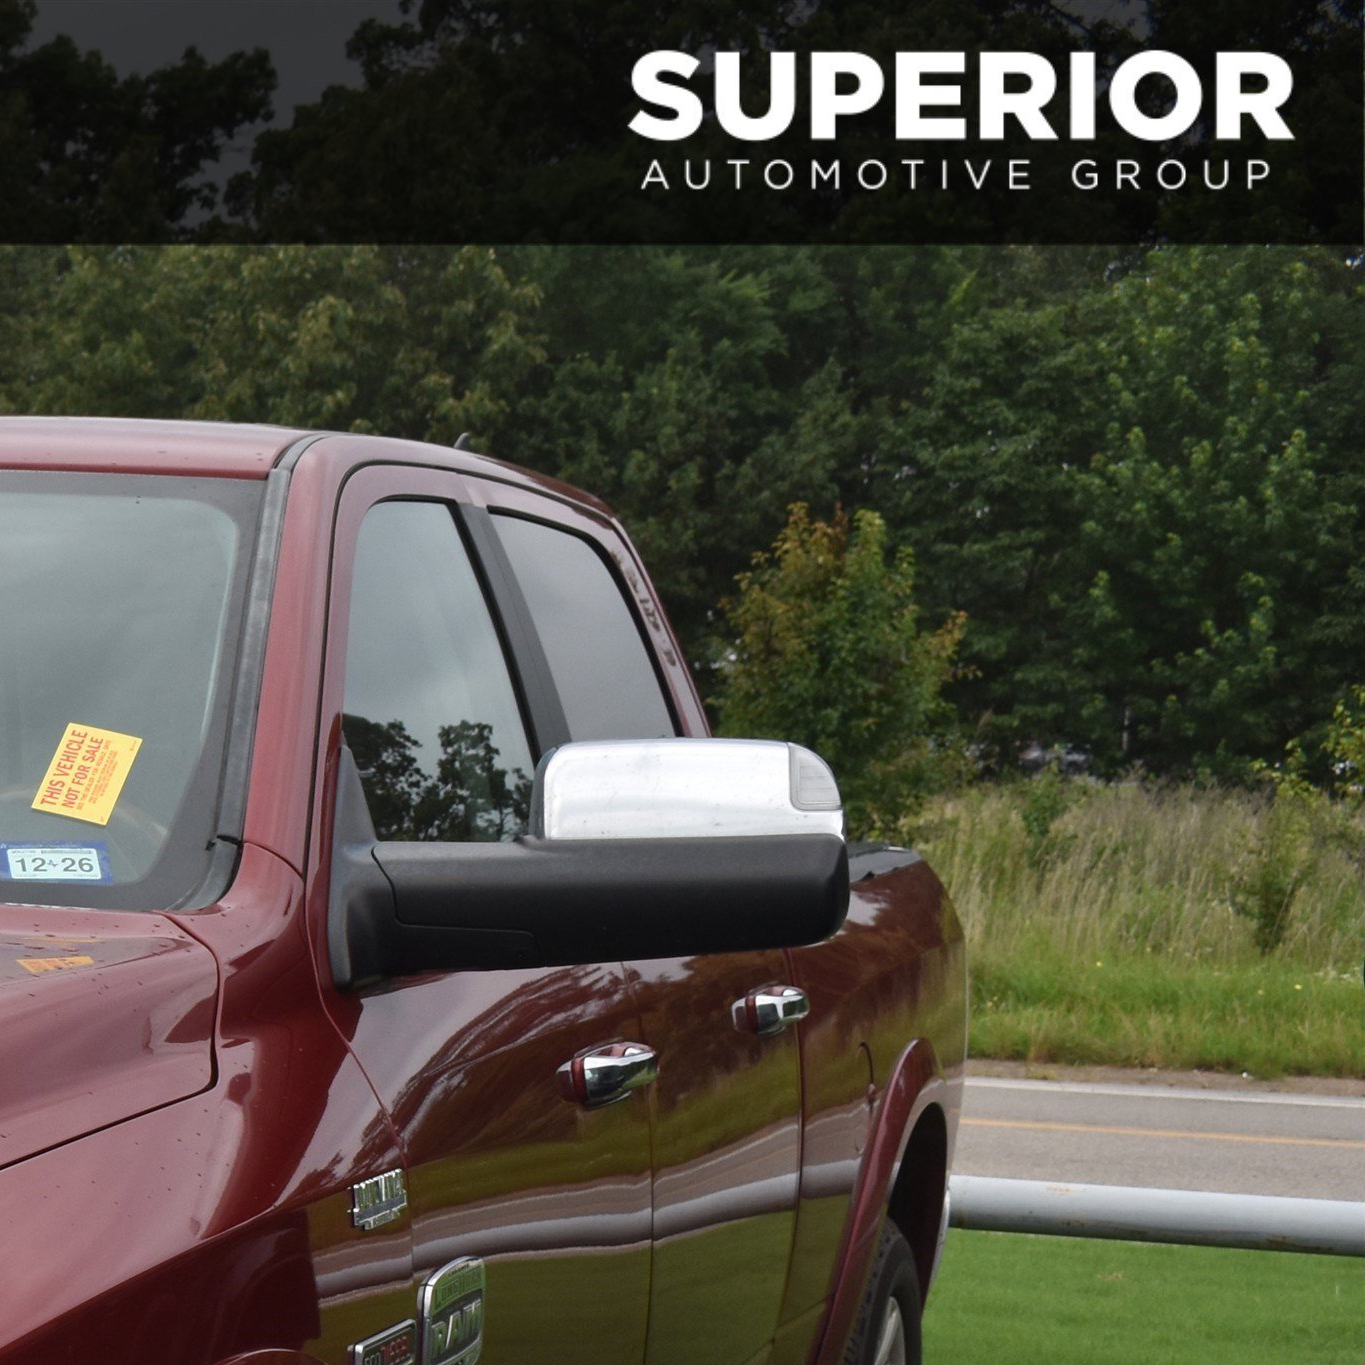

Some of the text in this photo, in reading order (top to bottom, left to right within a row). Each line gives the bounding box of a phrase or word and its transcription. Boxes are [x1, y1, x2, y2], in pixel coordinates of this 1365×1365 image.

[40, 730, 88, 805] THIS VEHICLE
[61, 787, 81, 809] NOT
[72, 765, 91, 786] FOR
[82, 737, 104, 763] SALE
[15, 857, 94, 873] 12 26
